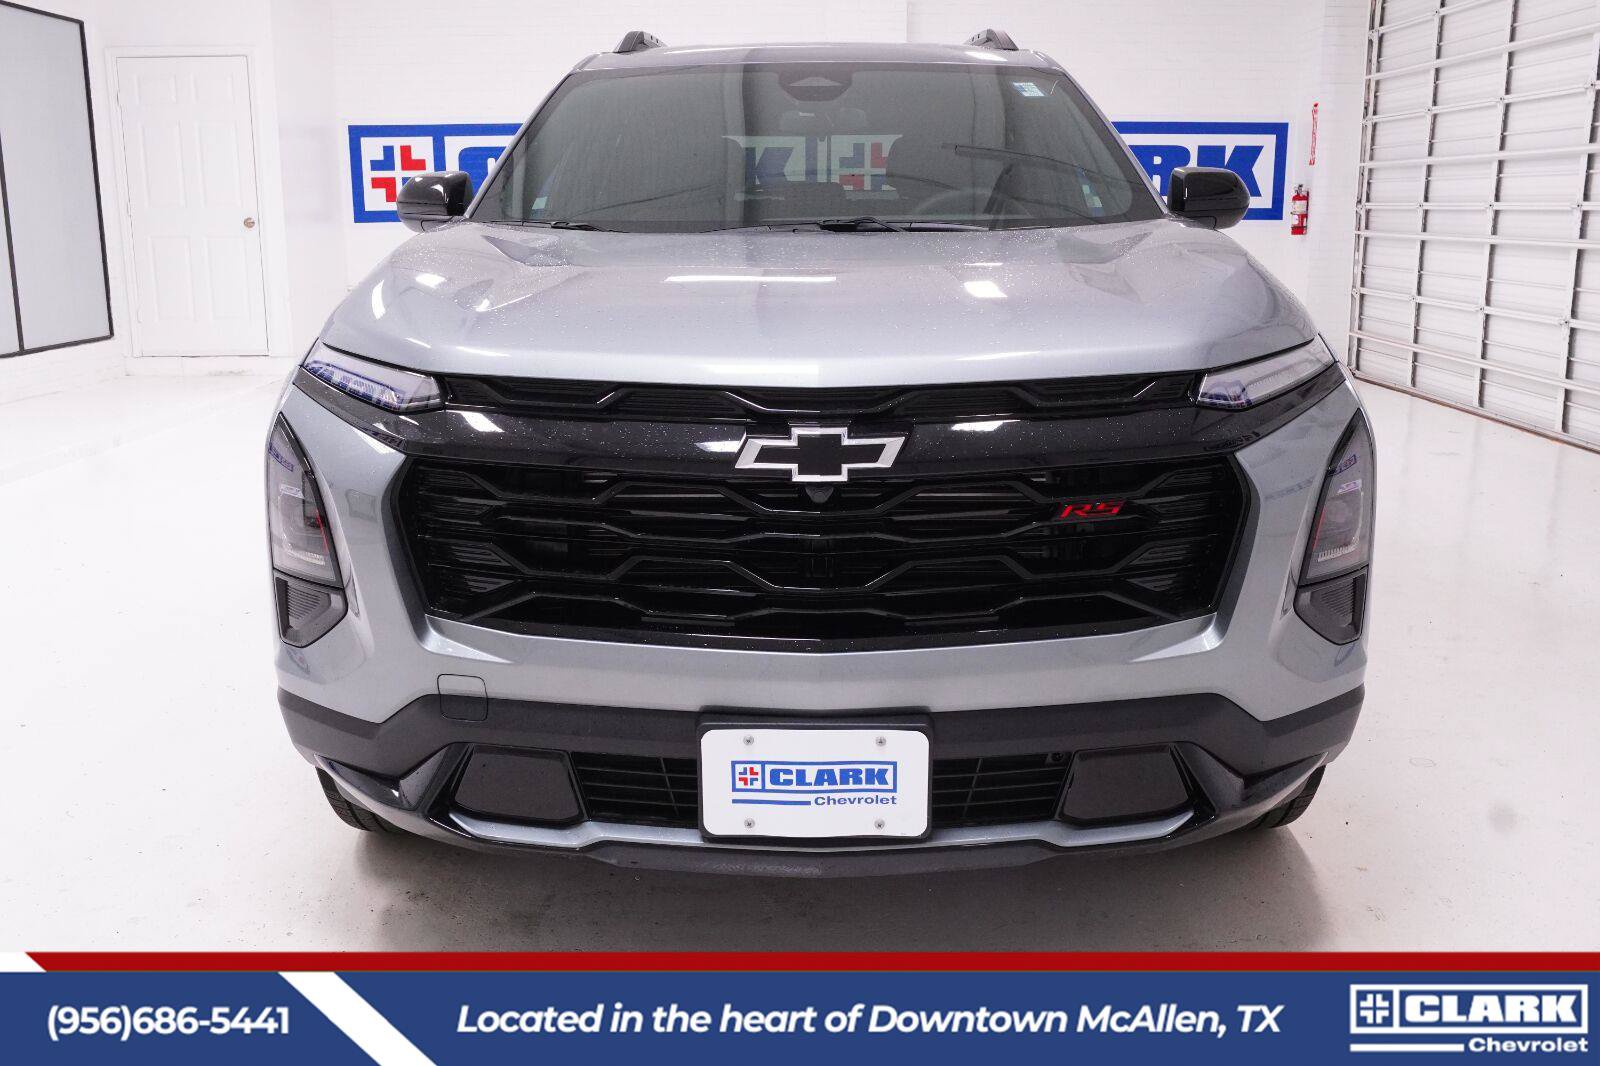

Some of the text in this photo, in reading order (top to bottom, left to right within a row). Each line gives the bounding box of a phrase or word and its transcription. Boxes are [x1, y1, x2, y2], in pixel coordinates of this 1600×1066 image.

[1060, 501, 1121, 519] RS
[769, 767, 889, 787] CLARK
[814, 794, 897, 806] Chevrolet
